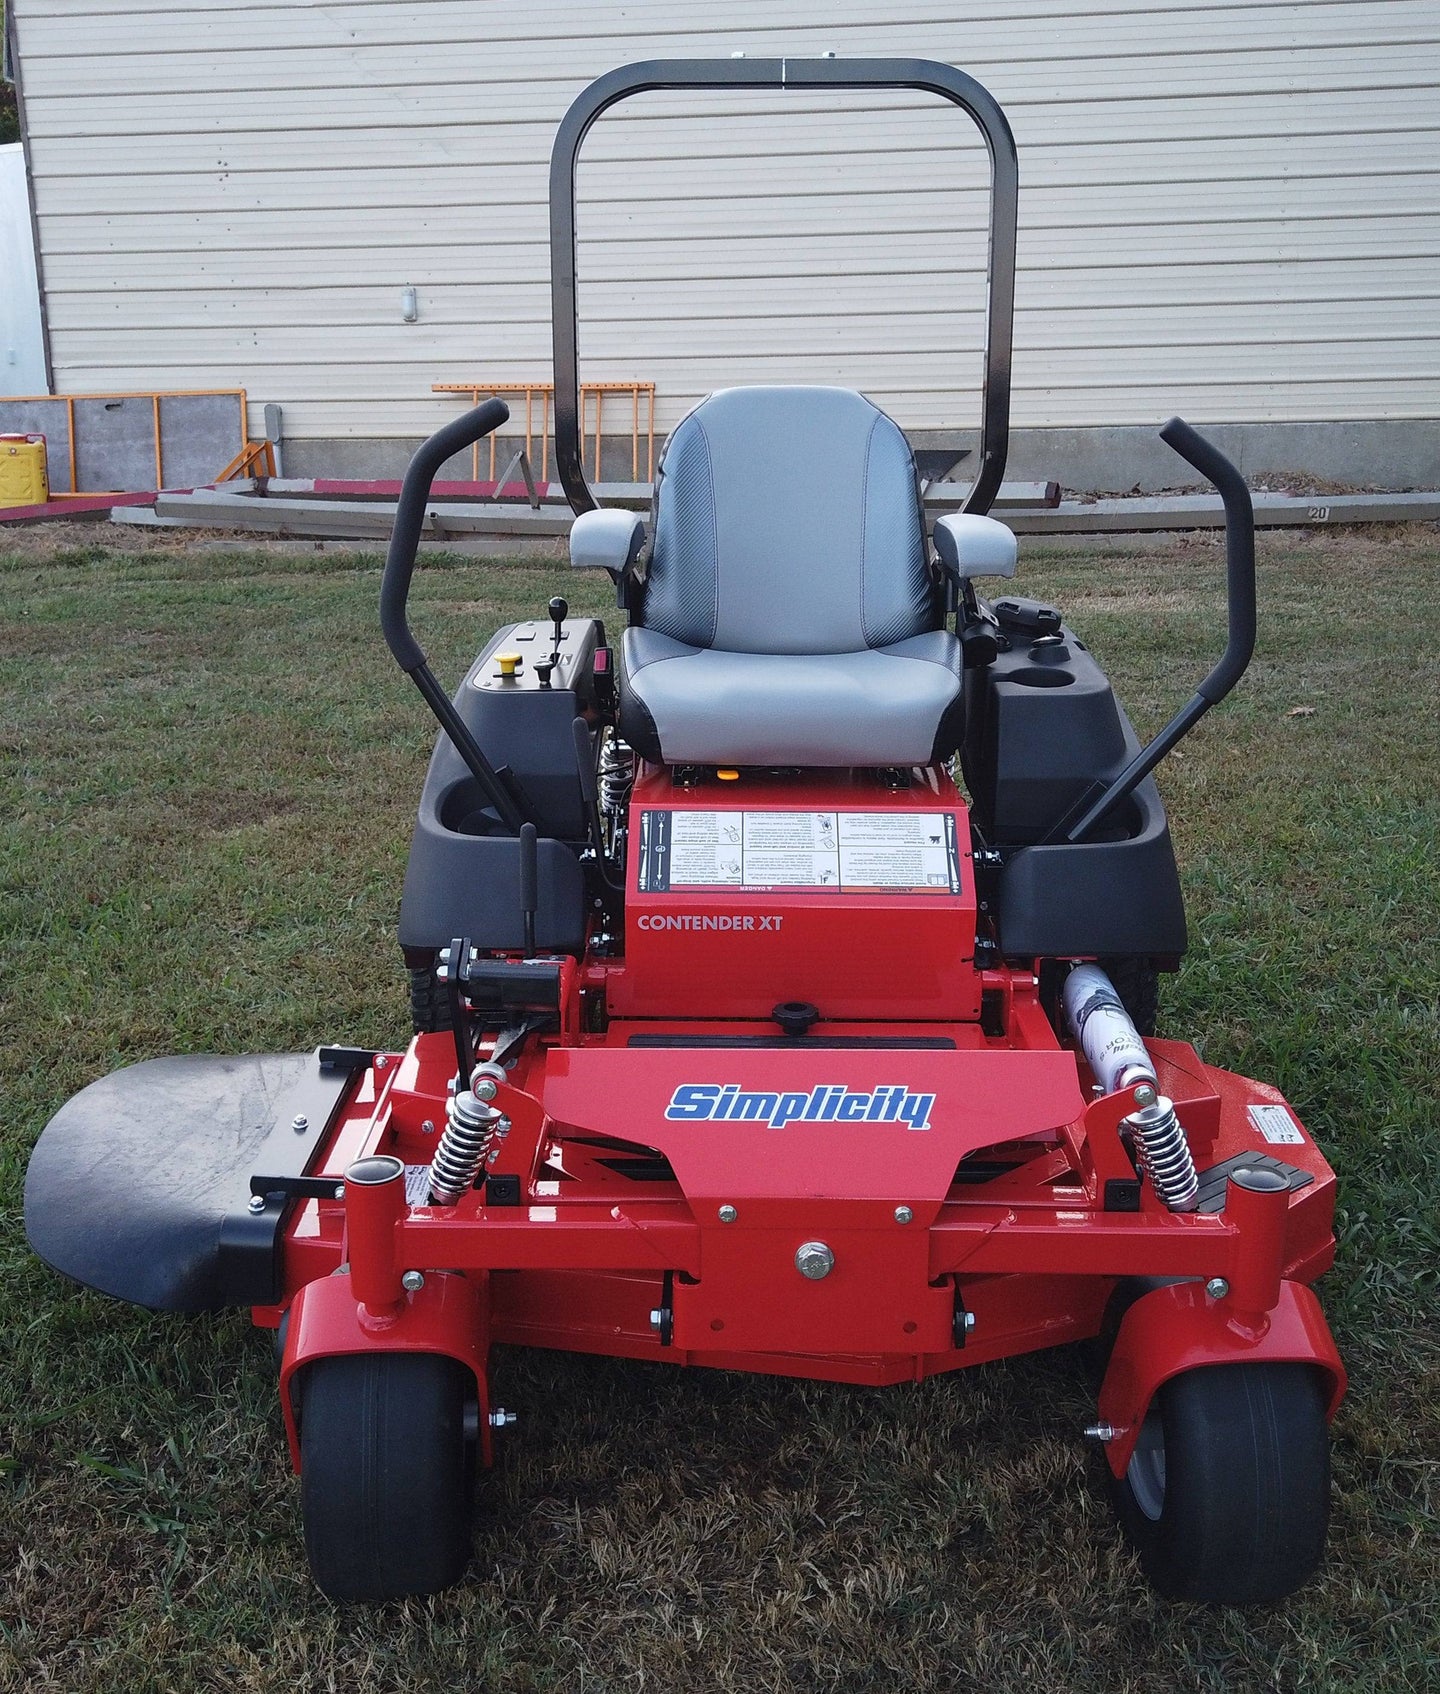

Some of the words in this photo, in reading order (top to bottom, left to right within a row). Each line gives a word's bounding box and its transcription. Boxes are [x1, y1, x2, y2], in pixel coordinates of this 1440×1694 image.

[1311, 507, 1326, 519] 20
[637, 914, 755, 931] CONTENDER
[758, 915, 784, 931] XT
[665, 1084, 937, 1130] Simplicity
